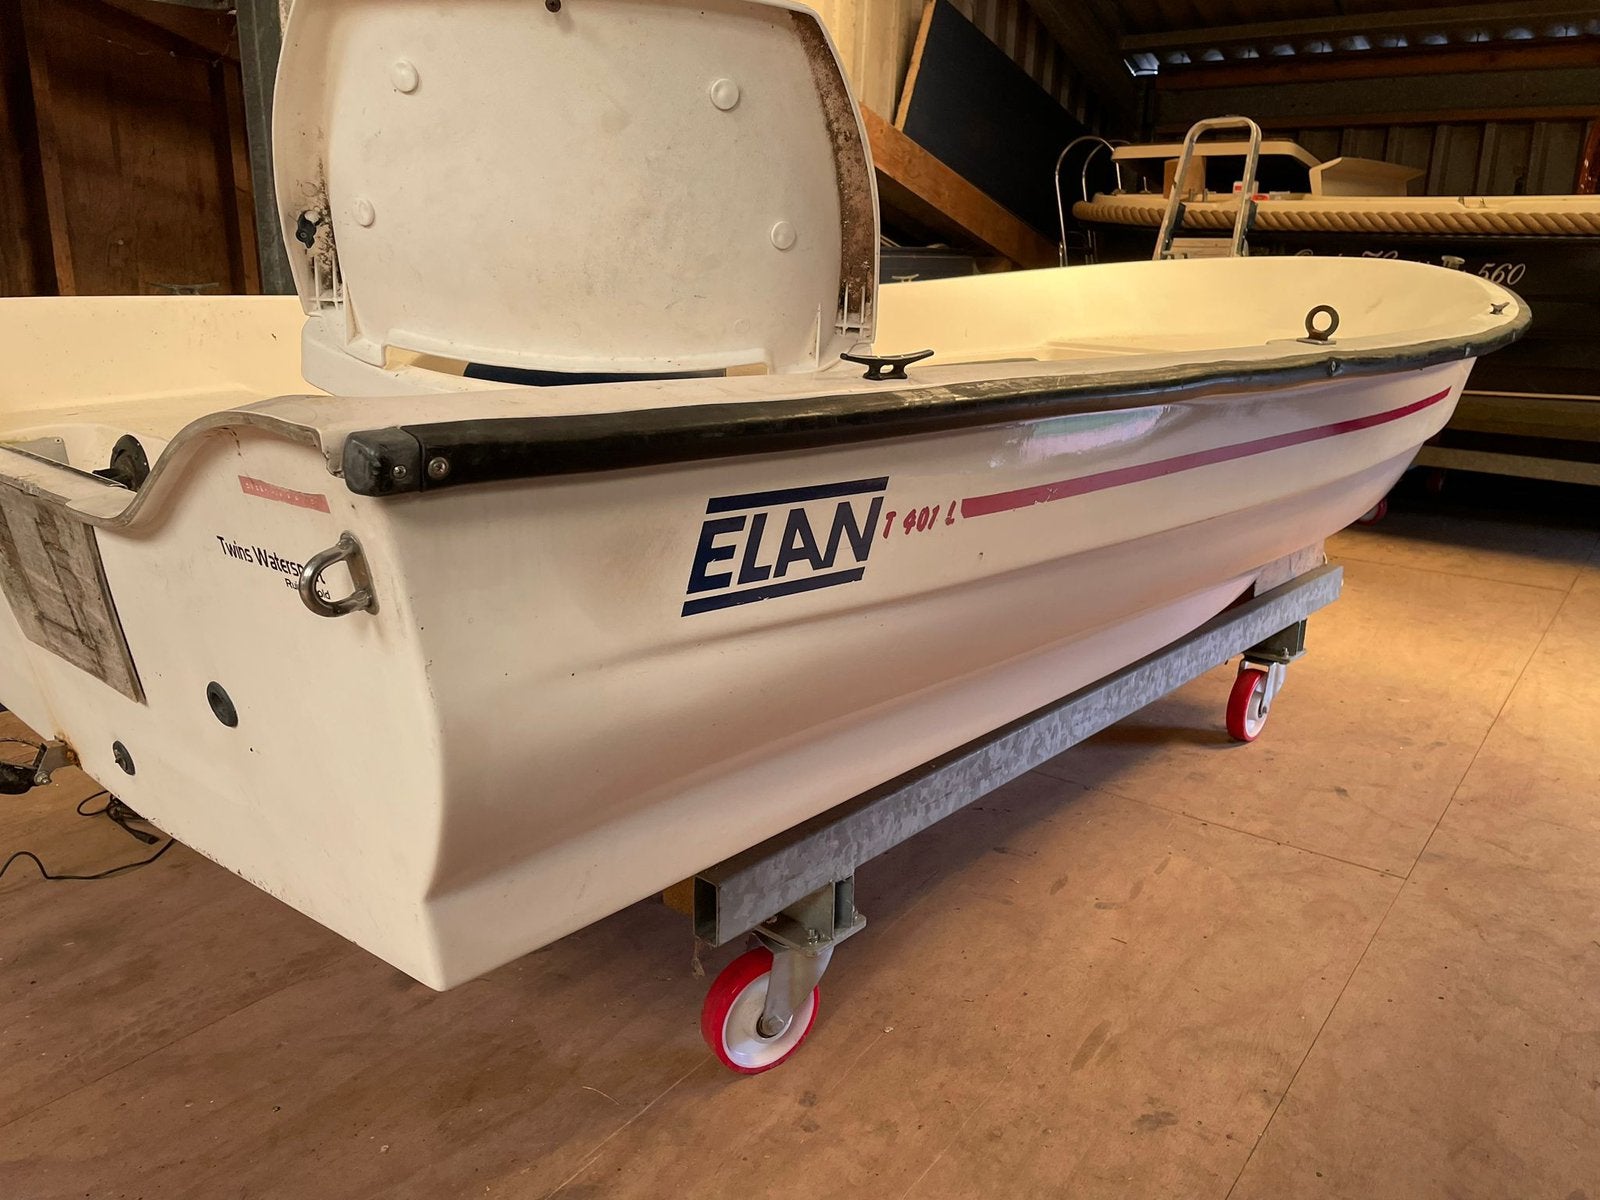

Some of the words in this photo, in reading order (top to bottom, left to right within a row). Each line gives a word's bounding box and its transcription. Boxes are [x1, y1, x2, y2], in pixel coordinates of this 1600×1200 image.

[1478, 263, 1526, 285] 560
[883, 511, 897, 539] T
[903, 505, 940, 535] 401
[216, 535, 254, 563] Twins
[686, 496, 885, 595] ELAN
